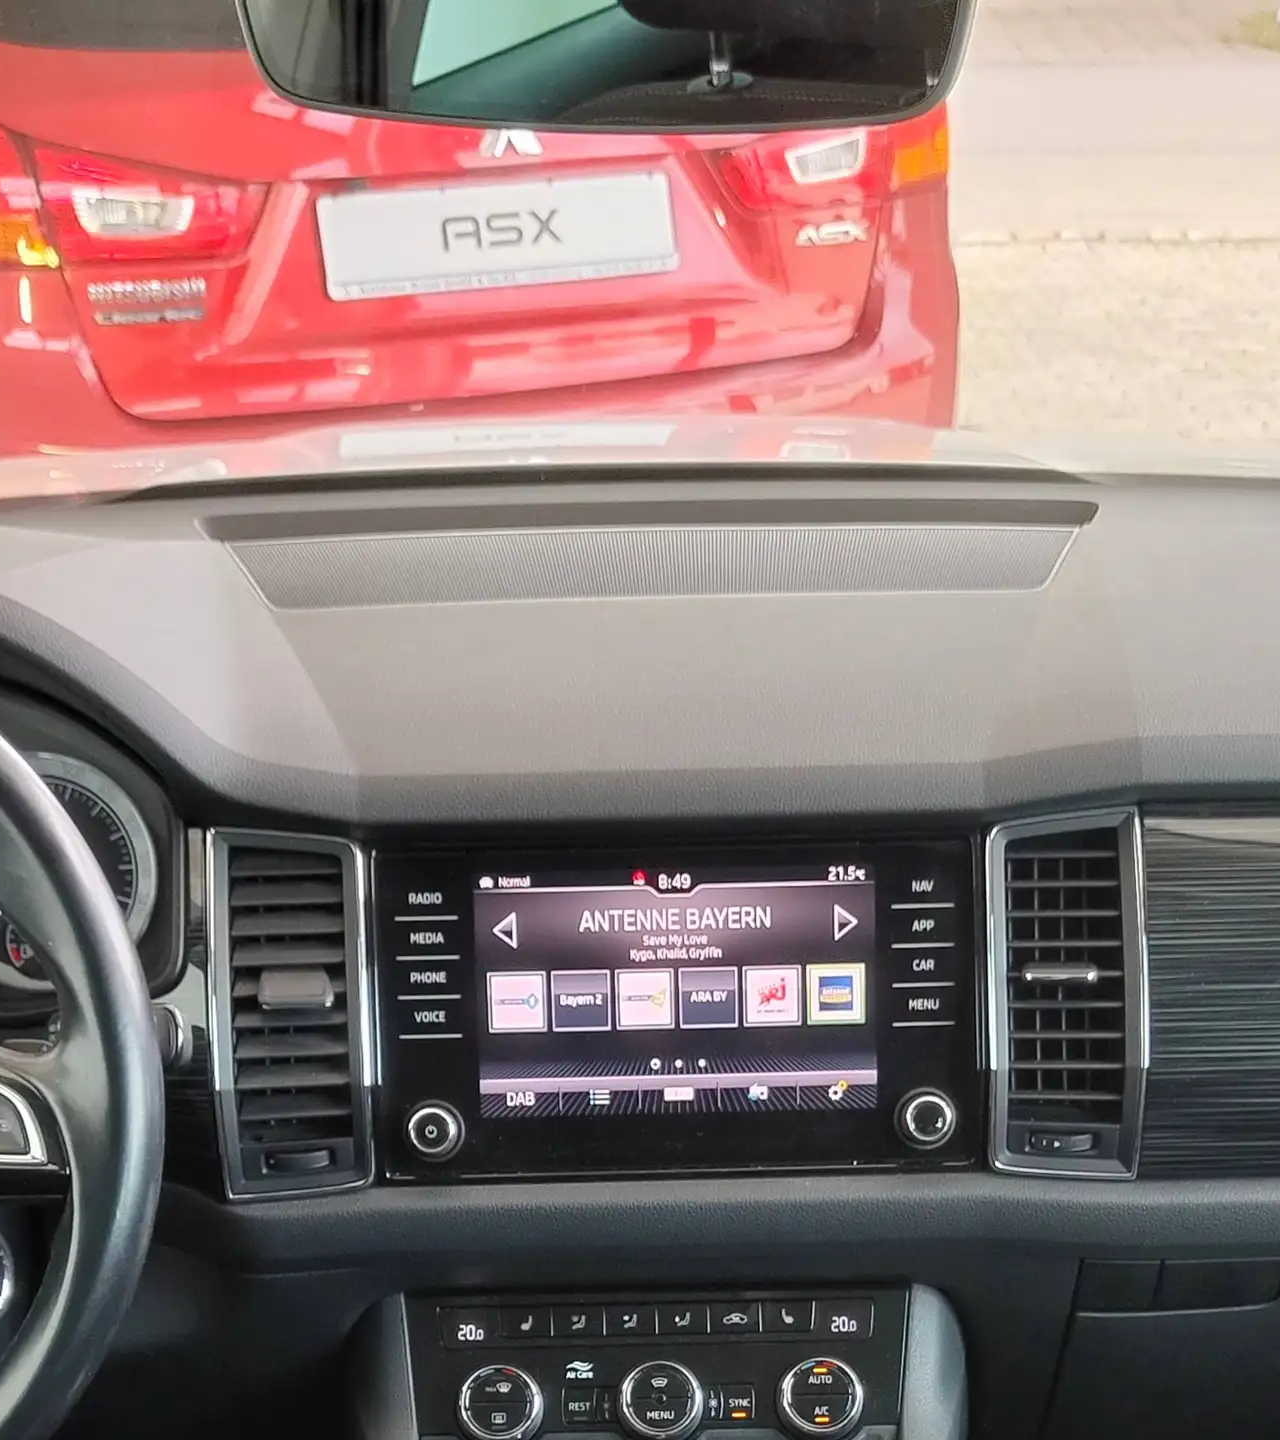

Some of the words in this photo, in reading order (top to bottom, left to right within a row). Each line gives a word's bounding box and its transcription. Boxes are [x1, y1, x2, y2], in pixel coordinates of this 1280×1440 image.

[441, 208, 562, 253] ASX
[795, 220, 868, 247] ASX
[498, 876, 531, 888] Normal
[657, 873, 692, 889] 8:49
[911, 879, 934, 892] NAV
[408, 892, 443, 905] RADIO
[578, 908, 681, 932] ANTENNE
[686, 906, 771, 930] BAYERN
[911, 919, 935, 932] APP
[410, 932, 445, 945] MEDIA
[642, 935, 667, 946] Save
[668, 934, 683, 947] My
[684, 934, 708, 946] Love
[689, 947, 723, 962] Gryffin
[912, 959, 935, 971] CAR
[410, 971, 447, 984] PHONE
[594, 994, 602, 1005] 2
[690, 992, 712, 1003] ARA
[908, 998, 940, 1011] MENU
[414, 1010, 446, 1023] VOICE
[506, 1091, 536, 1107] DAB
[830, 1315, 857, 1332] 20.0
[457, 1324, 484, 1341] 20.0
[808, 1375, 833, 1385] AUTO
[568, 1402, 591, 1412] REST
[728, 1398, 751, 1408] SYNC
[646, 1410, 675, 1420] MENU
[814, 1406, 829, 1416] A/C
